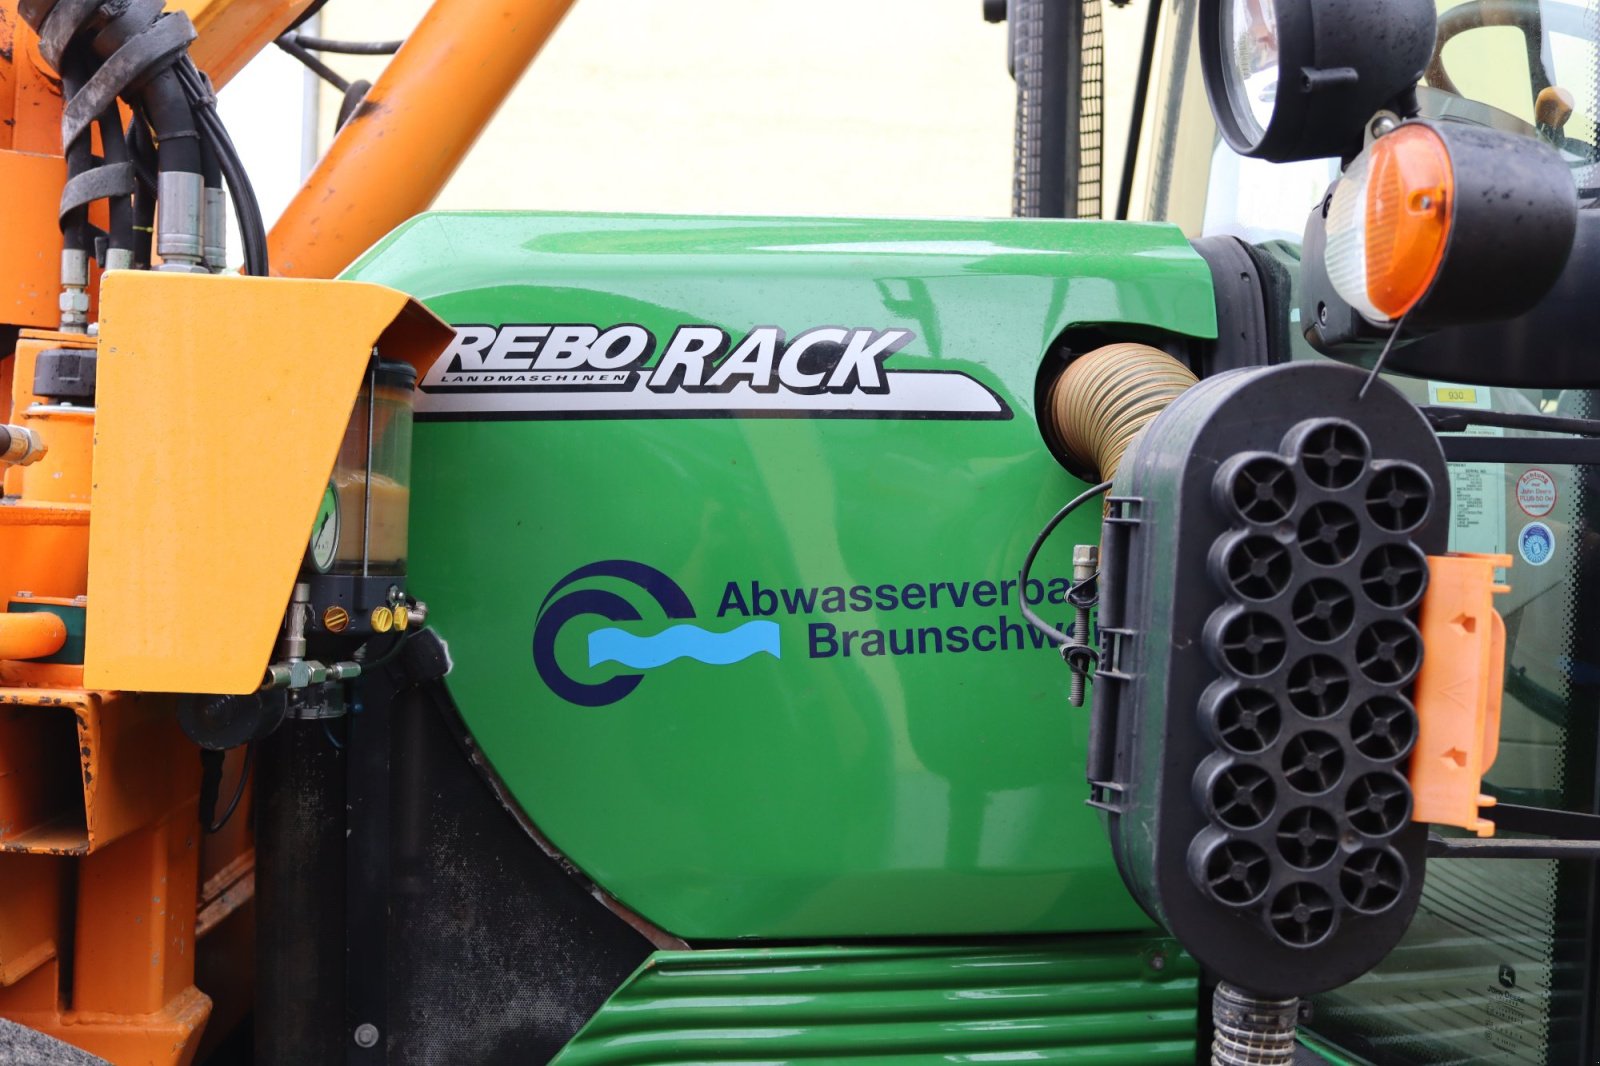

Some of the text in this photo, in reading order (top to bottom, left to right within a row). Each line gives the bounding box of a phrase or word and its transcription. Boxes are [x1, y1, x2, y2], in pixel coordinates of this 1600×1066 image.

[434, 323, 914, 394] REBO RACK
[440, 373, 627, 384] LANDMASCHINEN
[1448, 391, 1464, 399] 930
